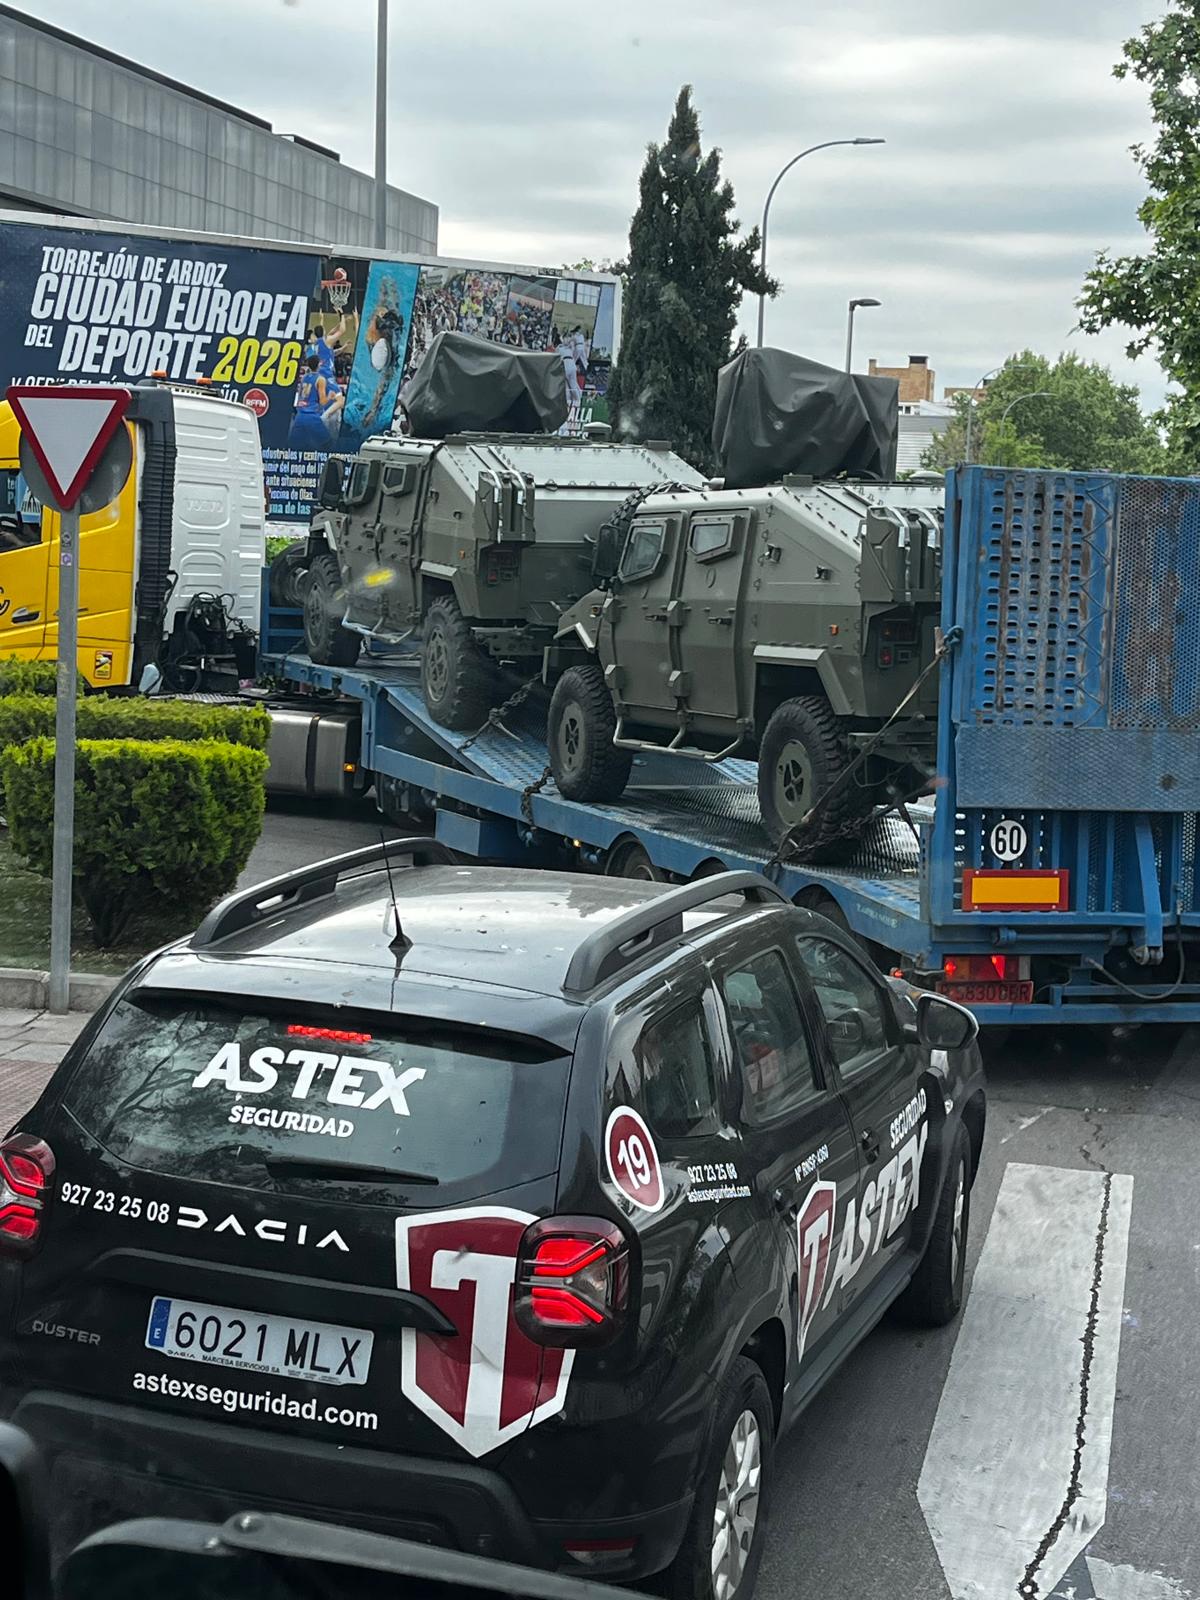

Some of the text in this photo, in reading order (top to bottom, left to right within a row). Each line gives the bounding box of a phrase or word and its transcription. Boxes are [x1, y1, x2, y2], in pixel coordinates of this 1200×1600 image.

[42, 246, 228, 288] TORREJÓN DE ARDOZ
[31, 273, 309, 340] CIUDAD EUROPEA
[24, 324, 303, 387] DEL DEPORTE 2026
[284, 501, 297, 514] de
[297, 501, 312, 515] las
[994, 825, 1021, 854] 60
[191, 1041, 426, 1117] ASTEX
[228, 1104, 355, 1139] SEGURIDAD
[889, 1087, 928, 1150] SEGURIDAD
[616, 1134, 651, 1191] 19
[687, 1165, 704, 1184] 927
[703, 1164, 717, 1182] 23
[714, 1163, 728, 1181] 25
[61, 1182, 170, 1224] 927 23 25 08
[177, 1205, 351, 1252] DACIA
[821, 1119, 929, 1312] ASTEX
[31, 1319, 101, 1347] DUSTER
[174, 1311, 363, 1379] 6021 MLX
[132, 1371, 379, 1432] astexseguridad.com
